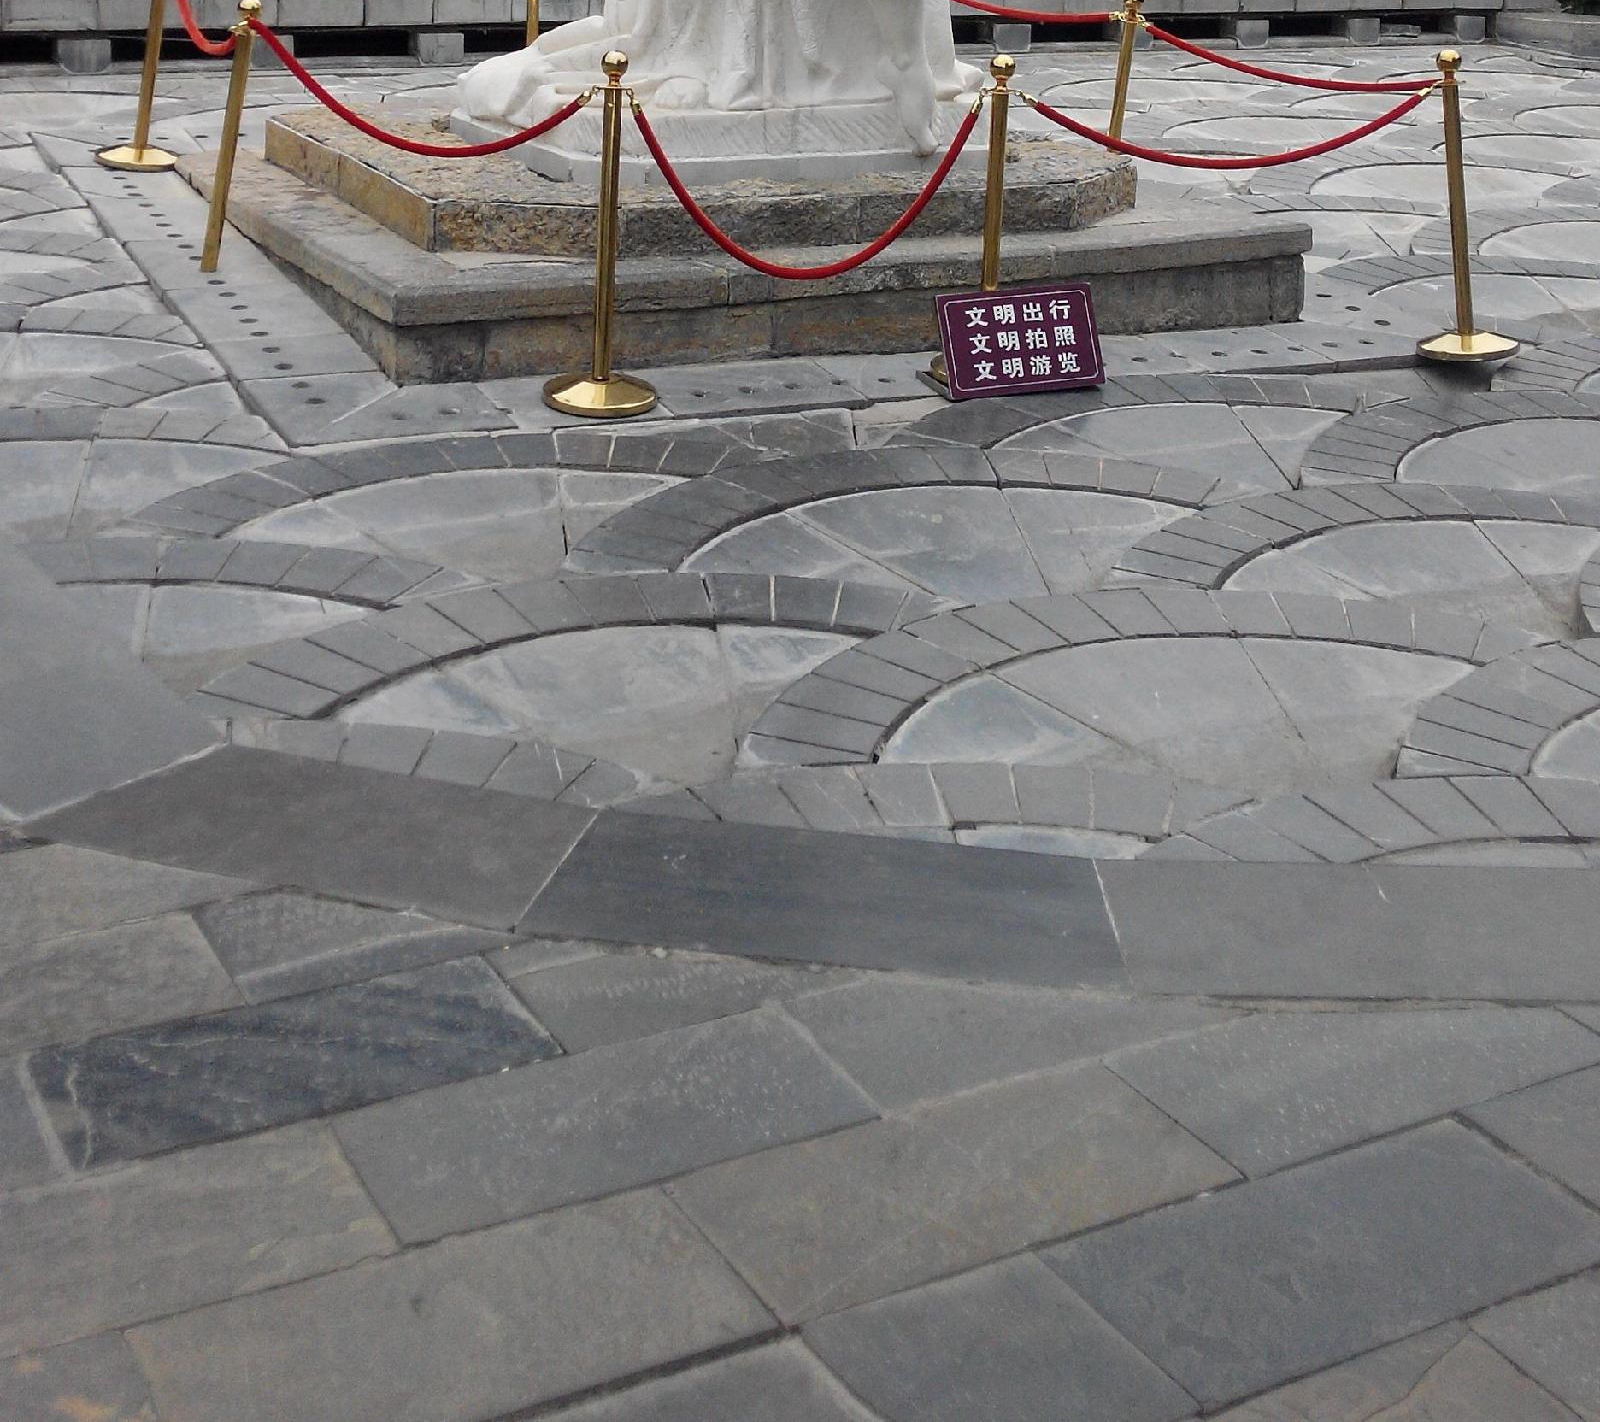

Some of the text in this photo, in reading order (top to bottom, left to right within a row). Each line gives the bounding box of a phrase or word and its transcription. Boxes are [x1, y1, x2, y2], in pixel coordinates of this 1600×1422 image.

[965, 299, 1071, 327] 文明出行
[969, 325, 1076, 354] 文明拍照
[973, 352, 1080, 381] 文明游览
